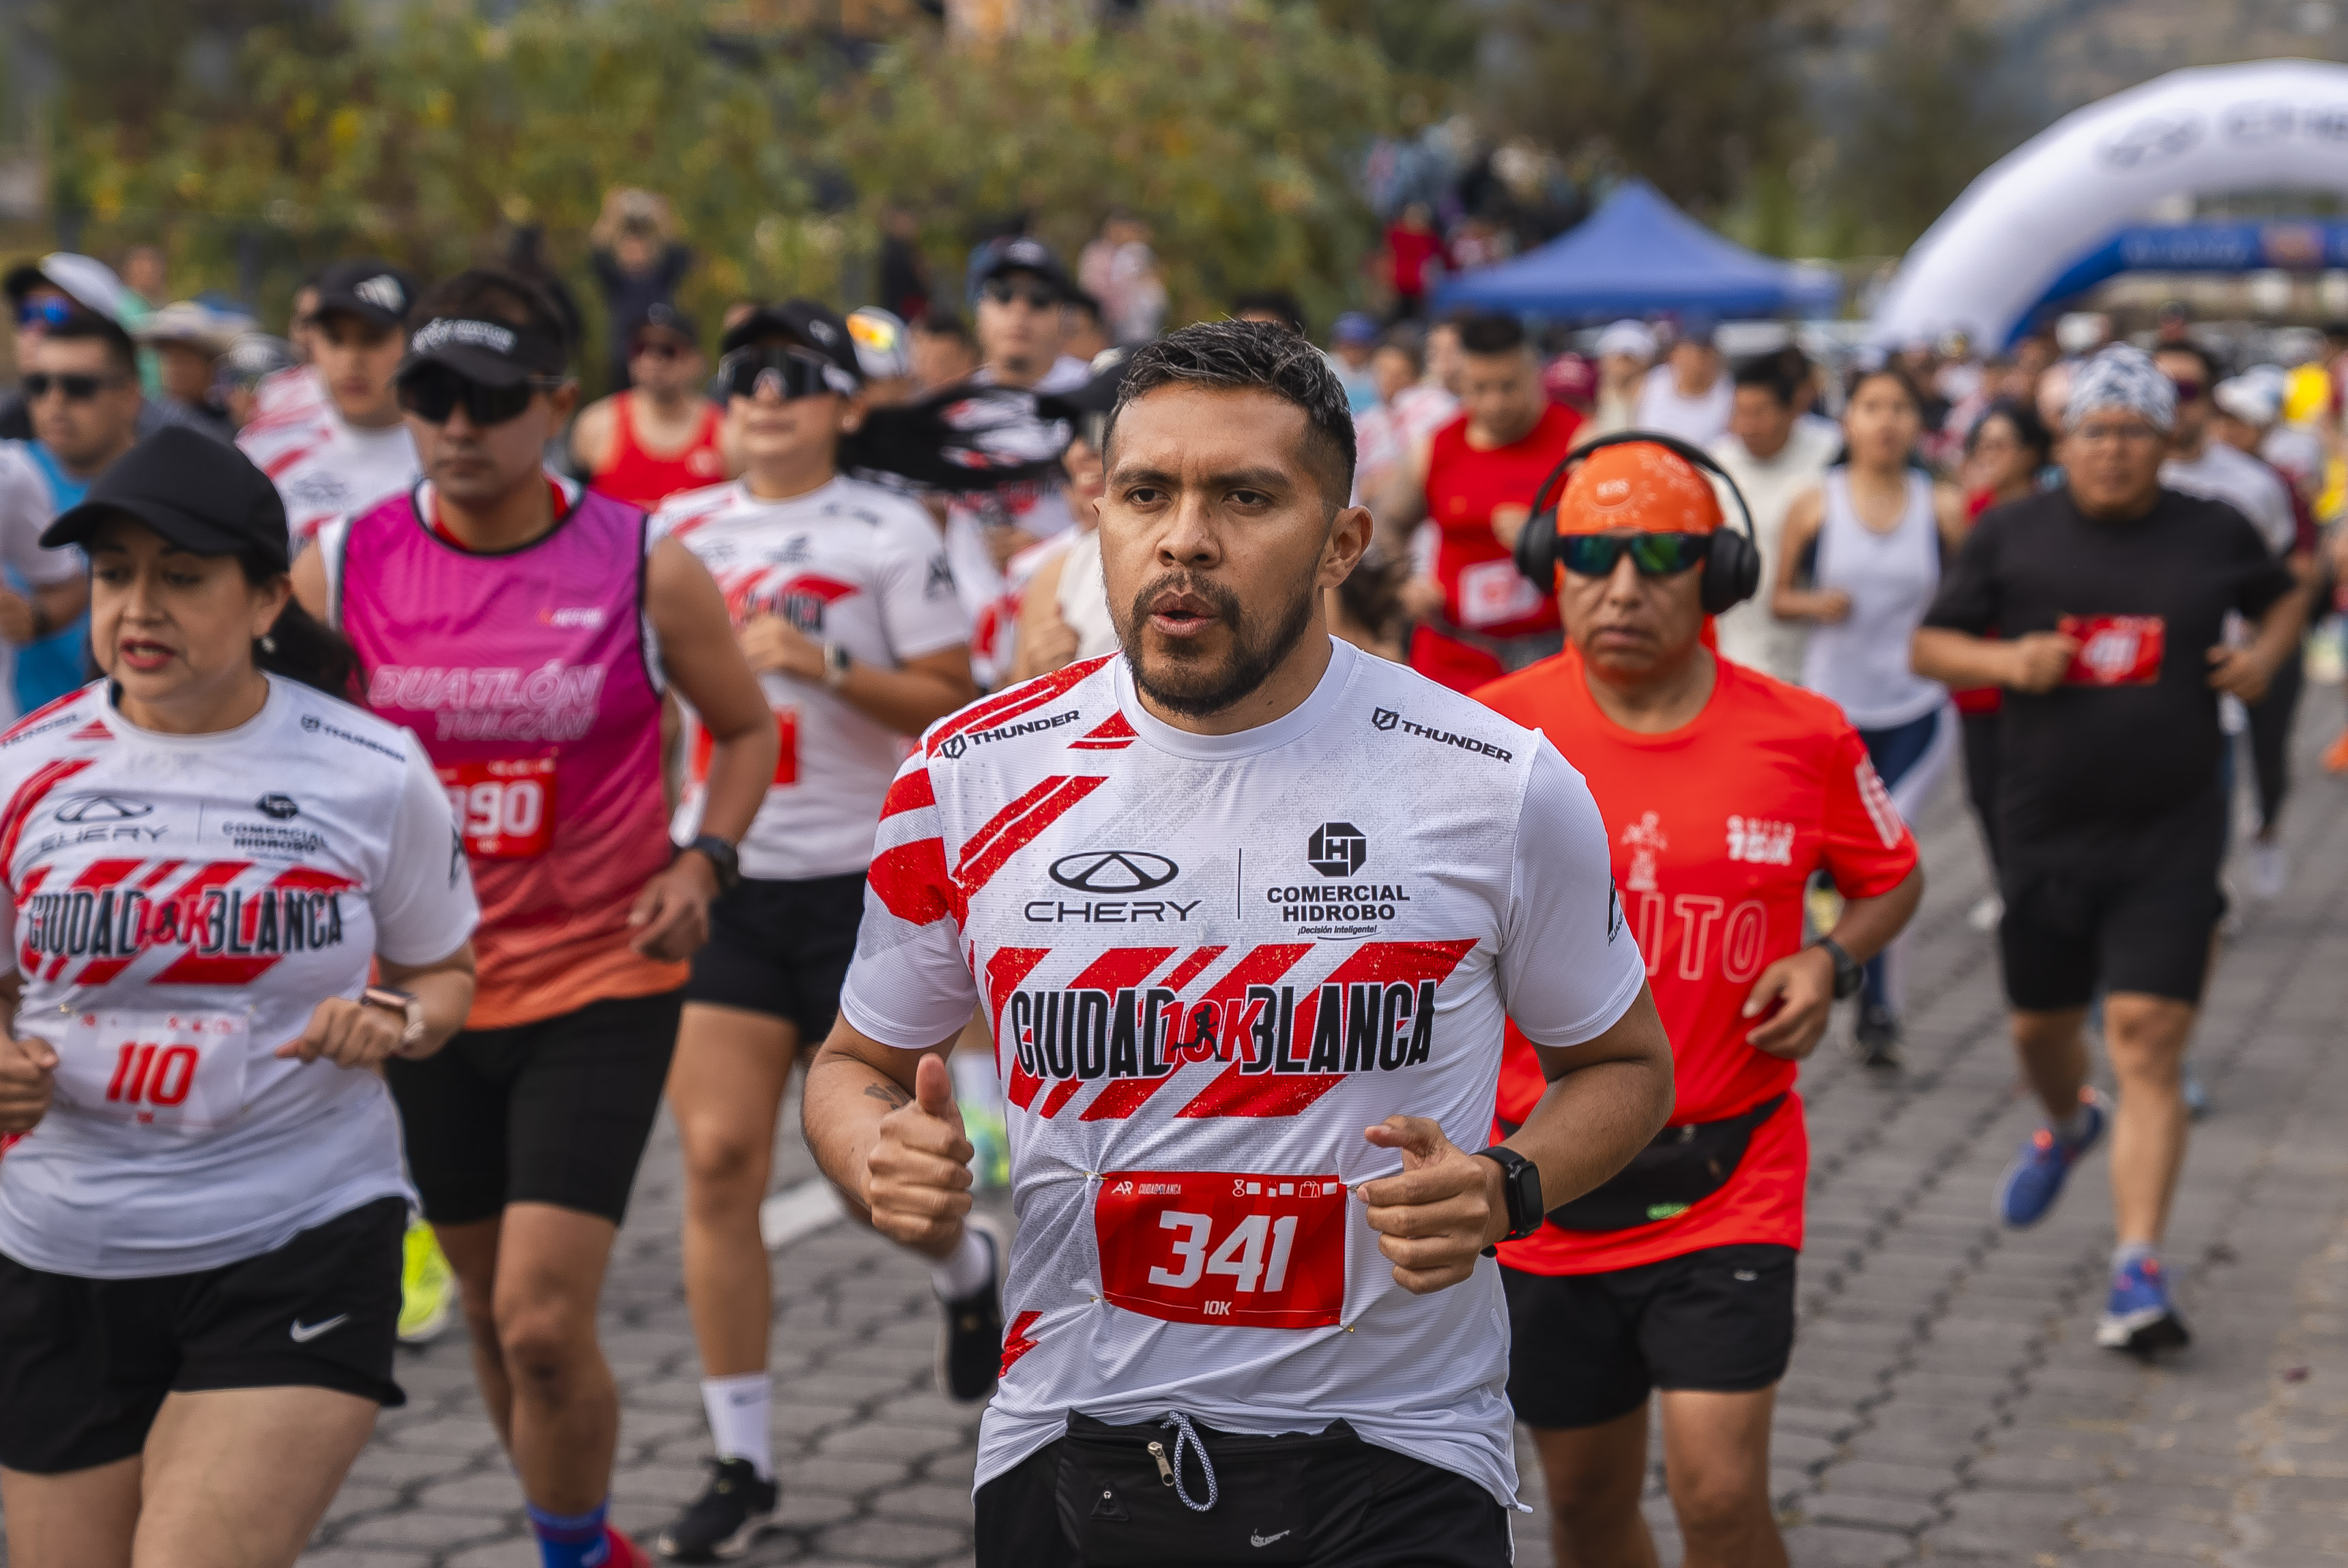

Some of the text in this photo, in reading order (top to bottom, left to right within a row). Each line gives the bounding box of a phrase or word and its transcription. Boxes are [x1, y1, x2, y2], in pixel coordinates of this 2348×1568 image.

[368, 658, 605, 711] DUATLÓN
[968, 710, 1082, 745] THUNDER
[1402, 720, 1513, 764] THUNDER
[1024, 900, 1202, 923] CHERY
[1267, 885, 1410, 903] COMERCIAL
[1283, 904, 1395, 922] HIDROBO
[29, 888, 145, 957] CIUDAD
[198, 887, 343, 955] BLANCA
[1011, 980, 1437, 1080] CIUDAD 10K BLANCA
[106, 1041, 199, 1107] 110
[1148, 1210, 1299, 1292] 341
[1203, 1301, 1232, 1316] 10K
